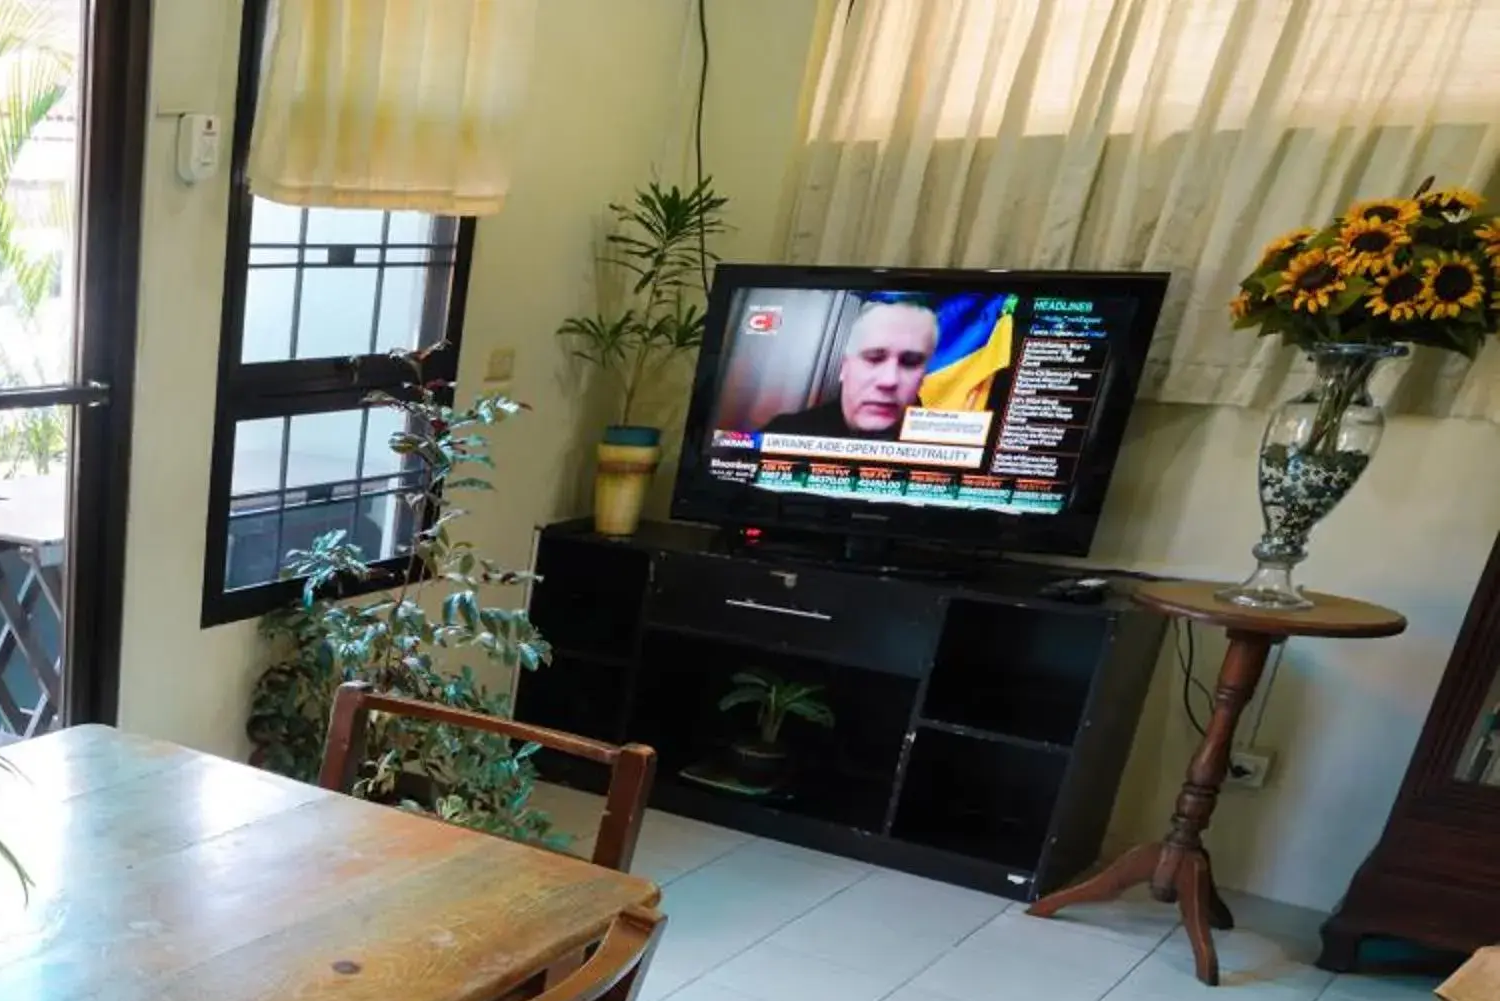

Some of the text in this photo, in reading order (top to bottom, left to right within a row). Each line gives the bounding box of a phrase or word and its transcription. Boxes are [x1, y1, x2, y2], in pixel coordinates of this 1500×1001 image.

[766, 437, 814, 449] UKRAINE
[845, 443, 878, 455] OPEN
[880, 446, 895, 457] TO
[896, 446, 970, 461] NEUTRALITY
[711, 459, 758, 473] Bloomberg
